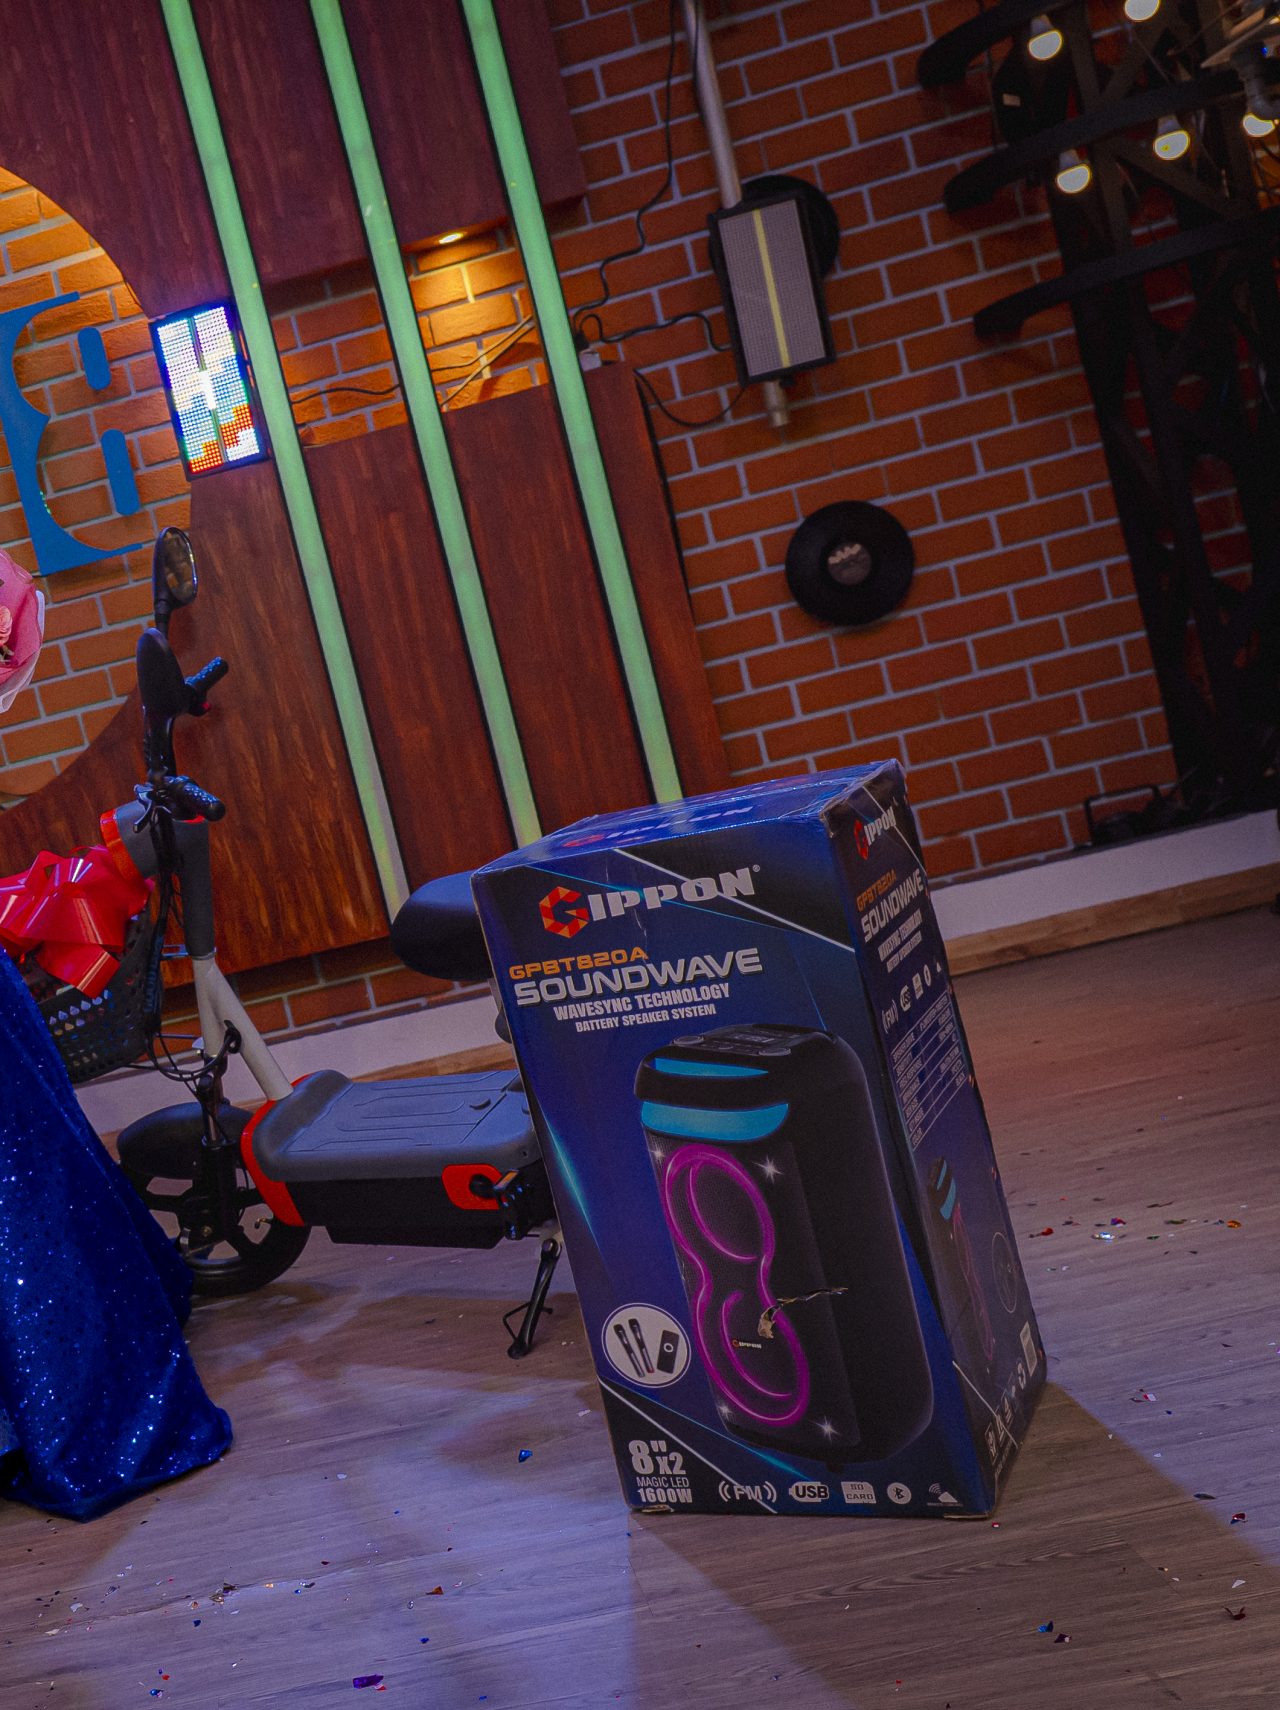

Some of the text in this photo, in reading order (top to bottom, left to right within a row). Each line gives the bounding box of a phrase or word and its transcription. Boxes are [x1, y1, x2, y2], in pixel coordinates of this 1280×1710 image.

[861, 868, 924, 943] SOUNDWAVE
[509, 947, 649, 980] GPBT820A
[514, 948, 763, 1006] SOUNDWAVE
[553, 983, 730, 1021] WAVESYNC TECHNOLOGY
[575, 1004, 717, 1032] BATTERY SPEAKER SYSTEM
[636, 1476, 690, 1488] MAGIC LED
[637, 1487, 693, 1503] 1600W
[733, 1485, 763, 1501] FM
[795, 1484, 829, 1499] USB
